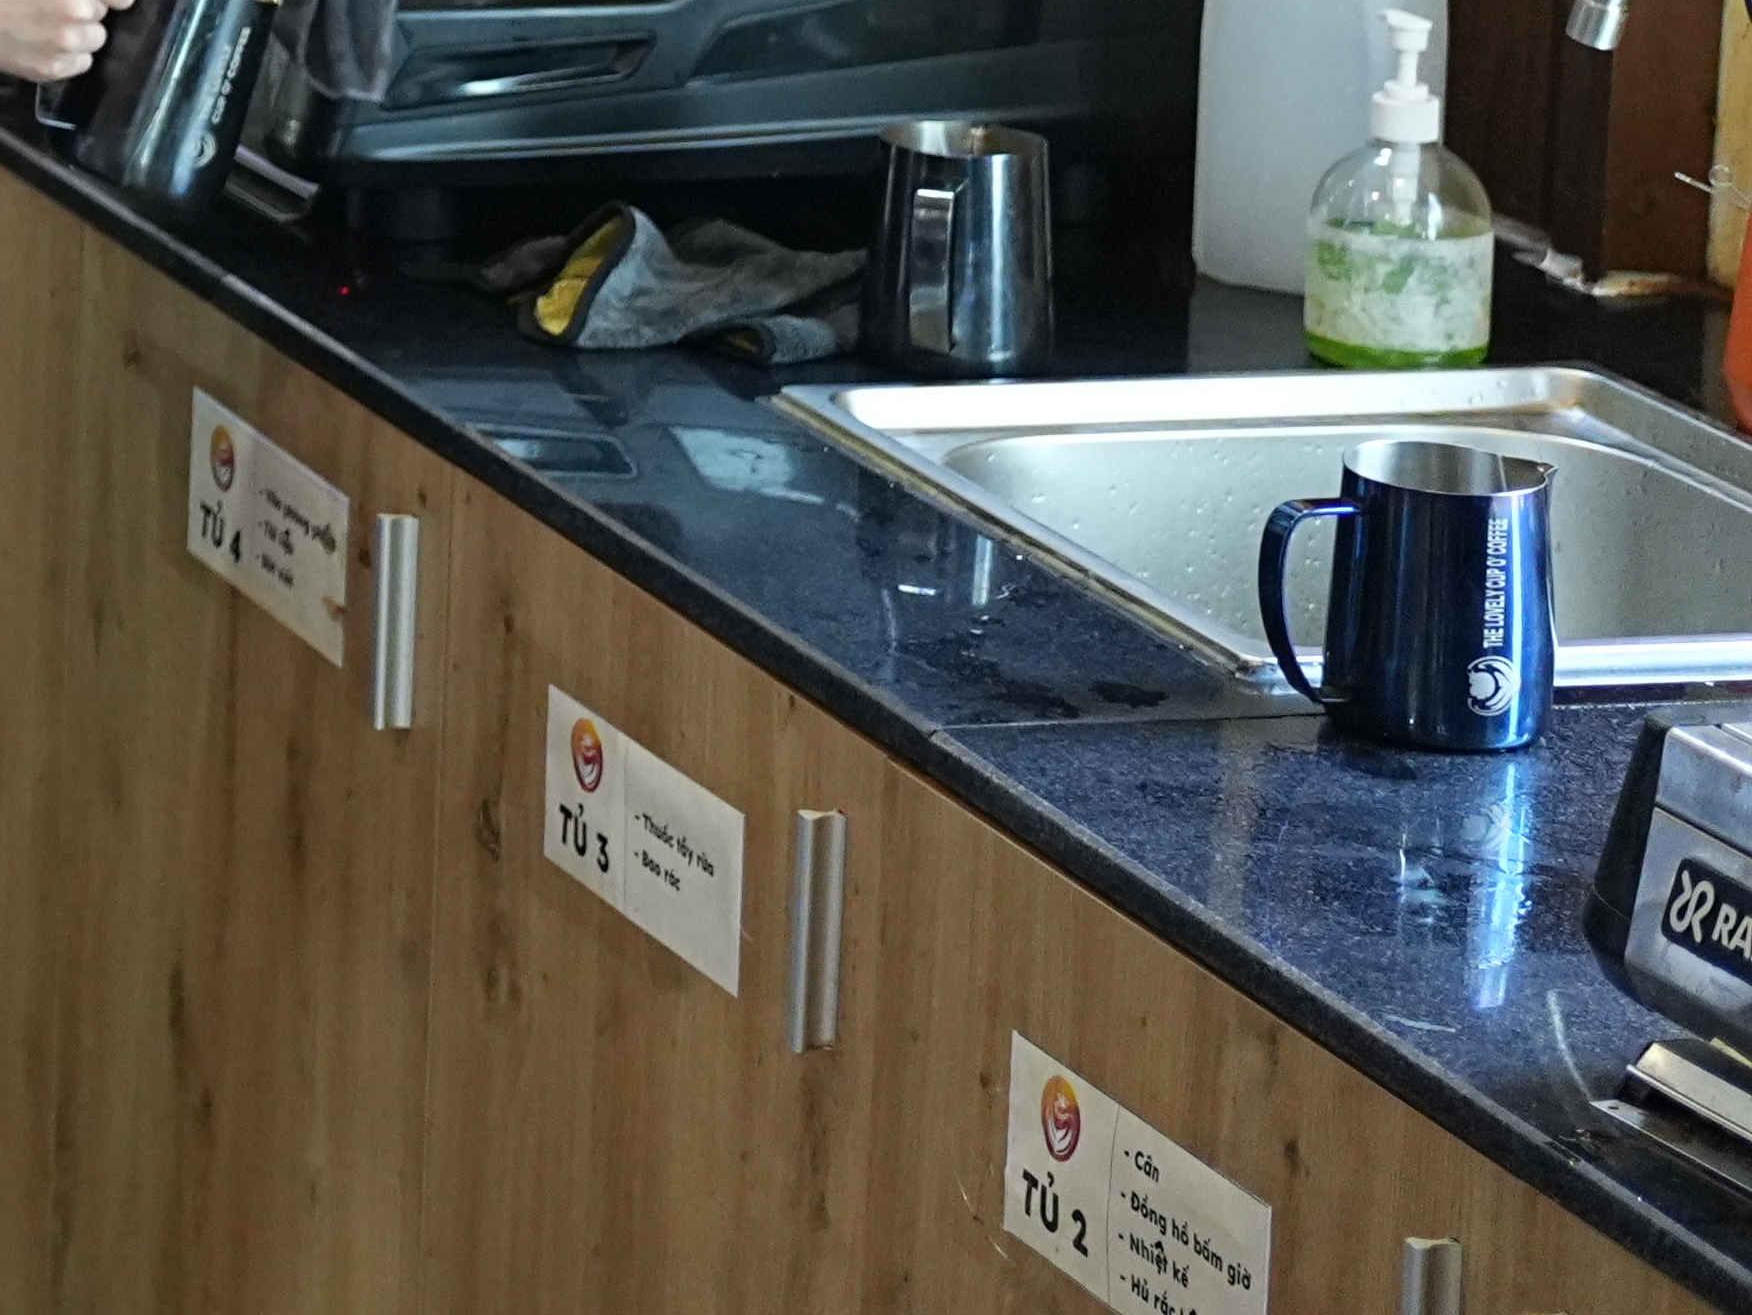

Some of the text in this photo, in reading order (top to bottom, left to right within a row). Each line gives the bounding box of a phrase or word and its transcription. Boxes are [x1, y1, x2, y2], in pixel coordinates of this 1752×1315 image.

[229, 530, 242, 565] 4
[1487, 517, 1509, 555] COFFEE
[1485, 567, 1506, 589] CUP
[1484, 589, 1506, 627] LOVELY
[1483, 627, 1505, 649] THE
[559, 802, 610, 873] TỦ 3
[1711, 902, 1752, 961] RA
[1134, 1149, 1160, 1183] Cân
[1022, 1168, 1088, 1259] TỦ 2
[1130, 1190, 1168, 1237] Đồng
[1171, 1217, 1190, 1246] hồ
[1227, 1262, 1252, 1291] giờ
[1172, 1260, 1190, 1289] kế
